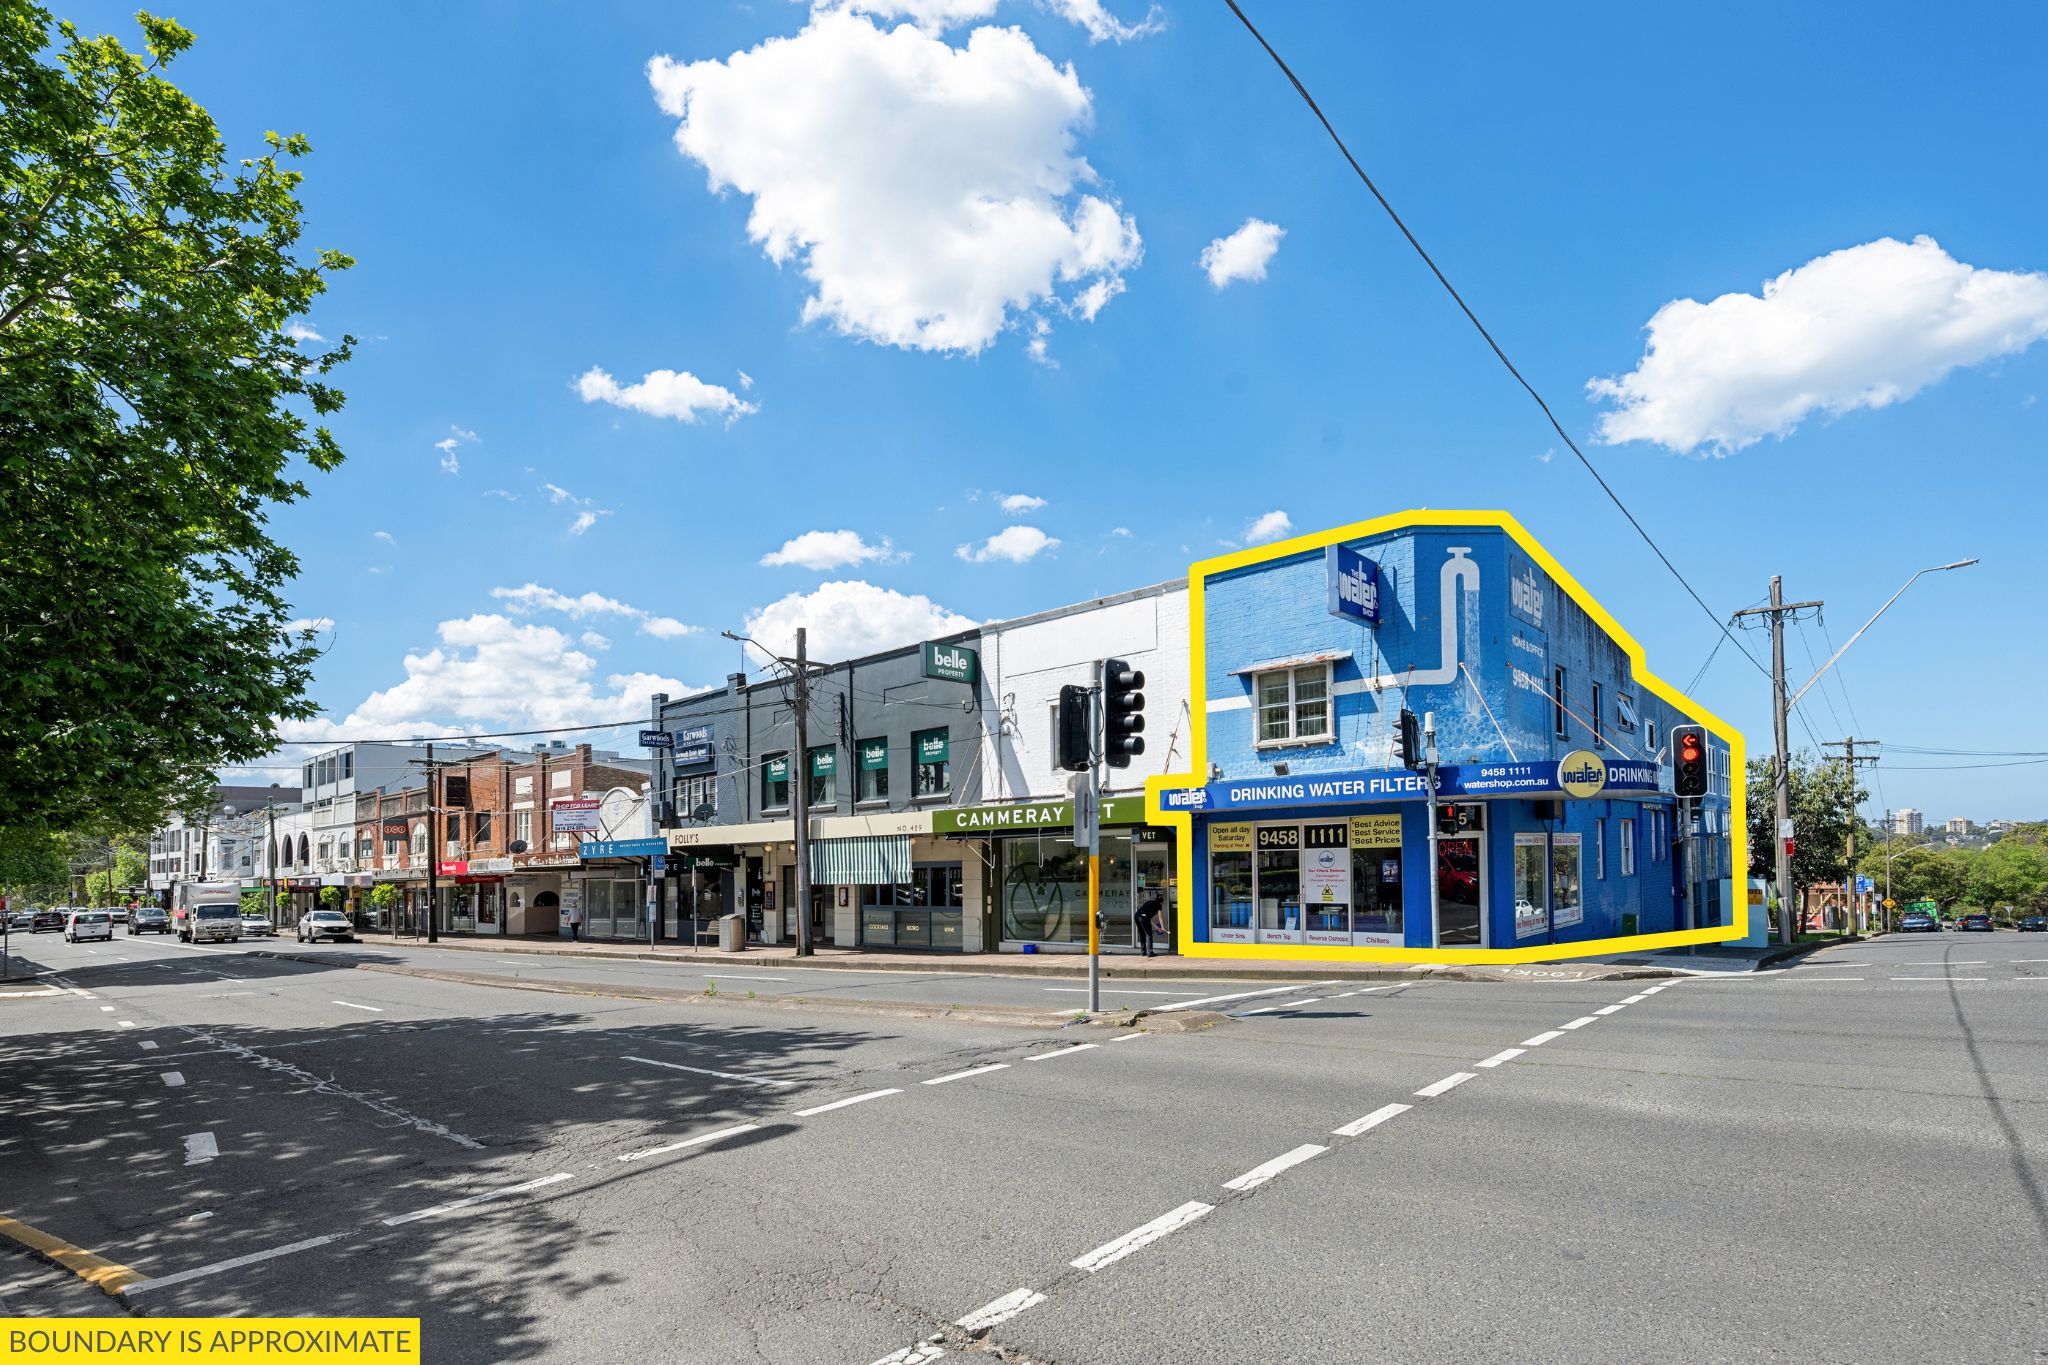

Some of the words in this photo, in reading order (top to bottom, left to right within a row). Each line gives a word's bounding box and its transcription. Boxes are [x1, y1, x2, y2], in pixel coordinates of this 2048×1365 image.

[934, 646, 968, 670] belle
[937, 668, 964, 678] PROPERTY
[641, 732, 670, 742] Garwoods
[683, 727, 708, 742] Garwoods
[924, 737, 944, 751] belle
[866, 746, 884, 759] belle
[817, 753, 833, 765] belle
[771, 760, 786, 772] belle
[1481, 767, 1506, 777] 9458
[1508, 766, 1531, 775] 1111
[1563, 761, 1604, 783] water
[1609, 767, 1652, 783] DRINKING
[1463, 778, 1549, 789] watershop.com.au
[1231, 783, 1304, 802] DRINKING
[1309, 780, 1365, 797] WATER
[956, 806, 1065, 827] CAMMERAY
[1458, 812, 1467, 825] 5
[1142, 831, 1156, 839] VET
[1212, 826, 1229, 834] Open
[1239, 825, 1251, 833] day
[1373, 828, 1400, 836] Service
[674, 833, 699, 844] FOLLY'S
[1218, 834, 1246, 843] Saturday
[1259, 830, 1298, 845] 9458
[1311, 828, 1343, 844] 1111
[583, 844, 614, 855] ZYRE
[1438, 841, 1473, 857] OPEN
[696, 858, 715, 867] belle
[1075, 889, 1130, 898] CAMERAY
[1283, 933, 1292, 941] Top
[1365, 936, 1390, 944] Chillers
